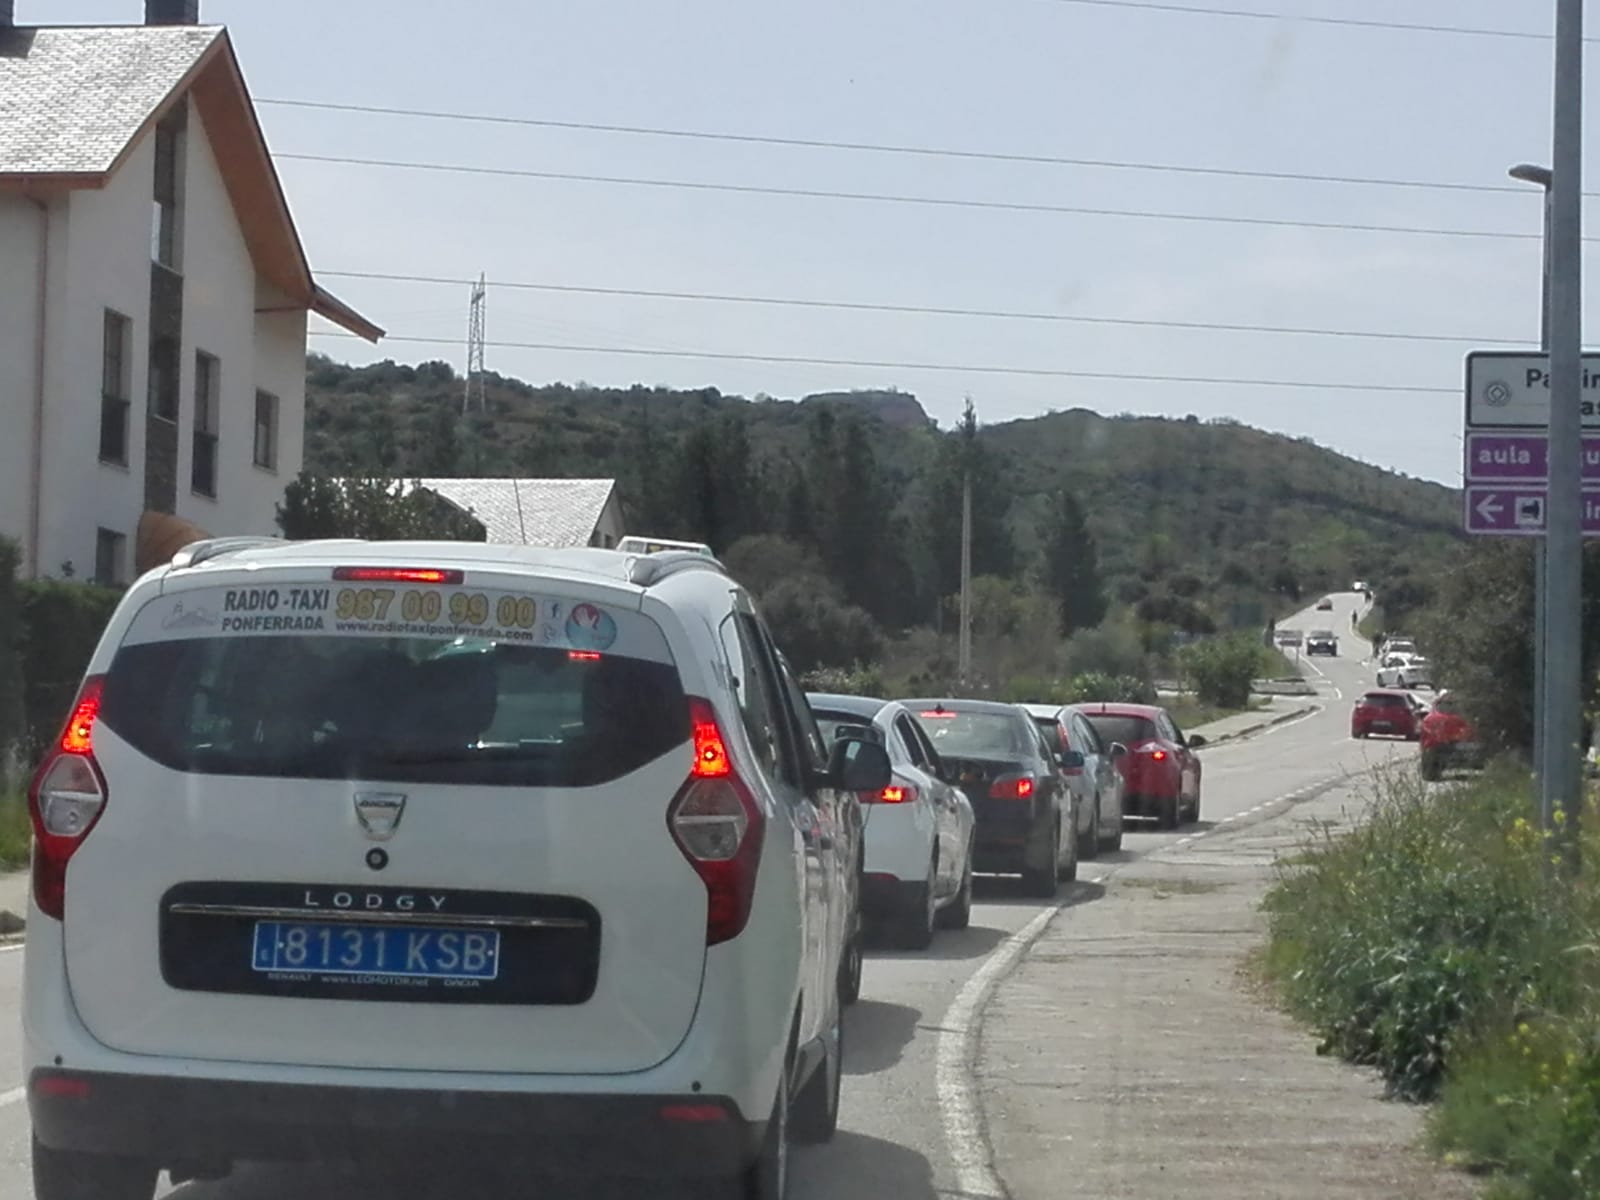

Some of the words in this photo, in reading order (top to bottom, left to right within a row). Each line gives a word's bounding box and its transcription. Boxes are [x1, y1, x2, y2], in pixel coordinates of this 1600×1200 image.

[1479, 446, 1530, 464] aula
[224, 589, 279, 611] RADIO
[336, 588, 396, 621] 987
[401, 590, 442, 622] 00
[449, 592, 489, 625] 99
[497, 595, 536, 629] 00
[222, 616, 324, 631] PONFERRADA
[305, 891, 446, 910] LODGY
[285, 926, 385, 968] 8131
[406, 931, 486, 971] KSB
[267, 972, 312, 982] RENAULT
